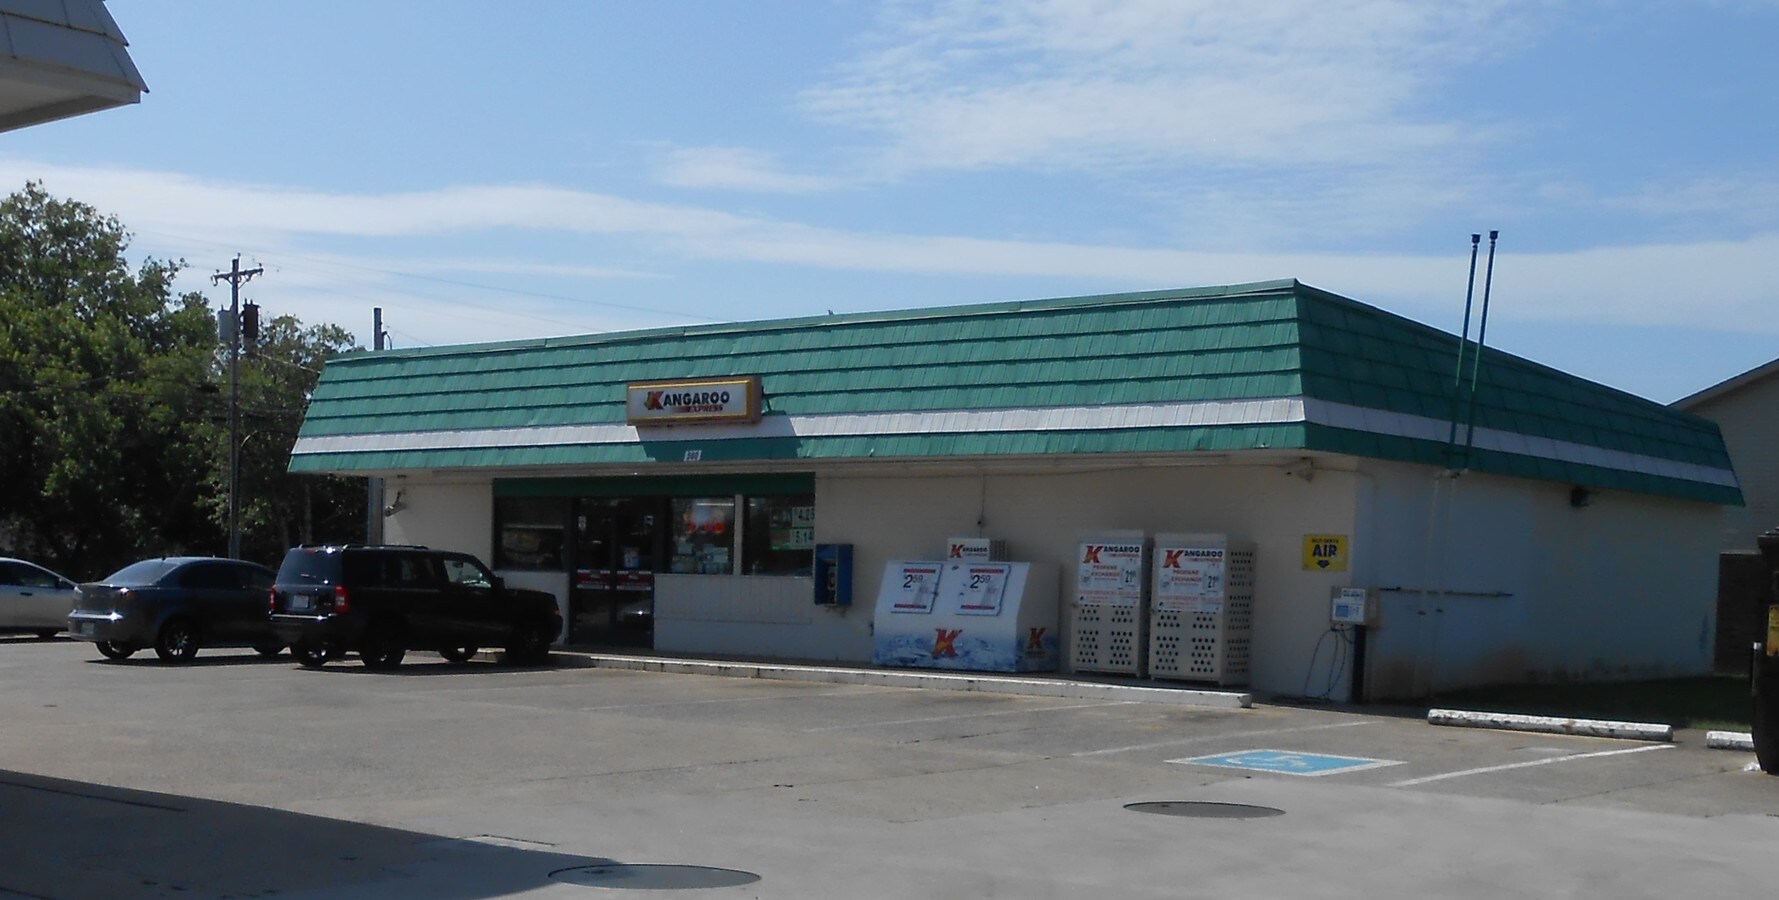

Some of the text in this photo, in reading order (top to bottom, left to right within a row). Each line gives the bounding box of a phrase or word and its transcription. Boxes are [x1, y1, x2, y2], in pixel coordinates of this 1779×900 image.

[645, 391, 730, 410] KANGAROO
[1083, 545, 1140, 564] KANGAROO
[1162, 549, 1223, 569] KANGAROO
[1312, 544, 1337, 557] AIR
[932, 627, 963, 658] K
